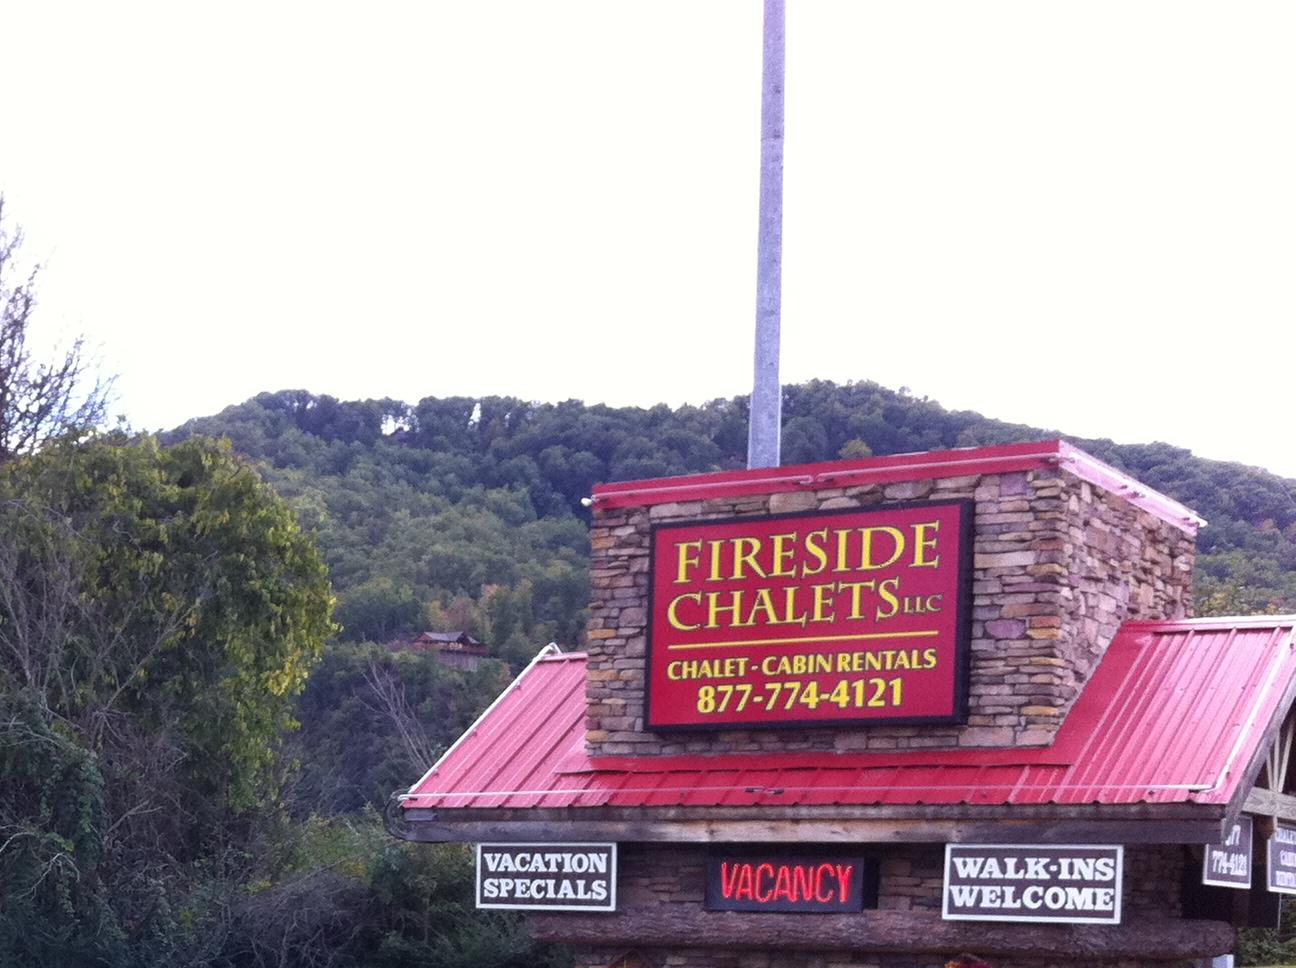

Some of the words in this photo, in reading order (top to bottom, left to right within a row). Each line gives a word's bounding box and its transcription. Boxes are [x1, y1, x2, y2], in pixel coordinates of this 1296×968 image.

[673, 519, 940, 584] FIRESIDE
[667, 576, 900, 631] CHALETS
[904, 594, 943, 615] LLC
[667, 657, 749, 681] CHALET
[762, 653, 833, 676] CABIN
[836, 648, 938, 673] RENTALS
[696, 677, 904, 714] 877-774-4121
[483, 853, 608, 873] VACATION
[952, 857, 1115, 881] WALK-INS
[483, 878, 608, 900] SPECIALS
[721, 862, 853, 903] VACANCY
[949, 885, 1115, 911] WELCOME
